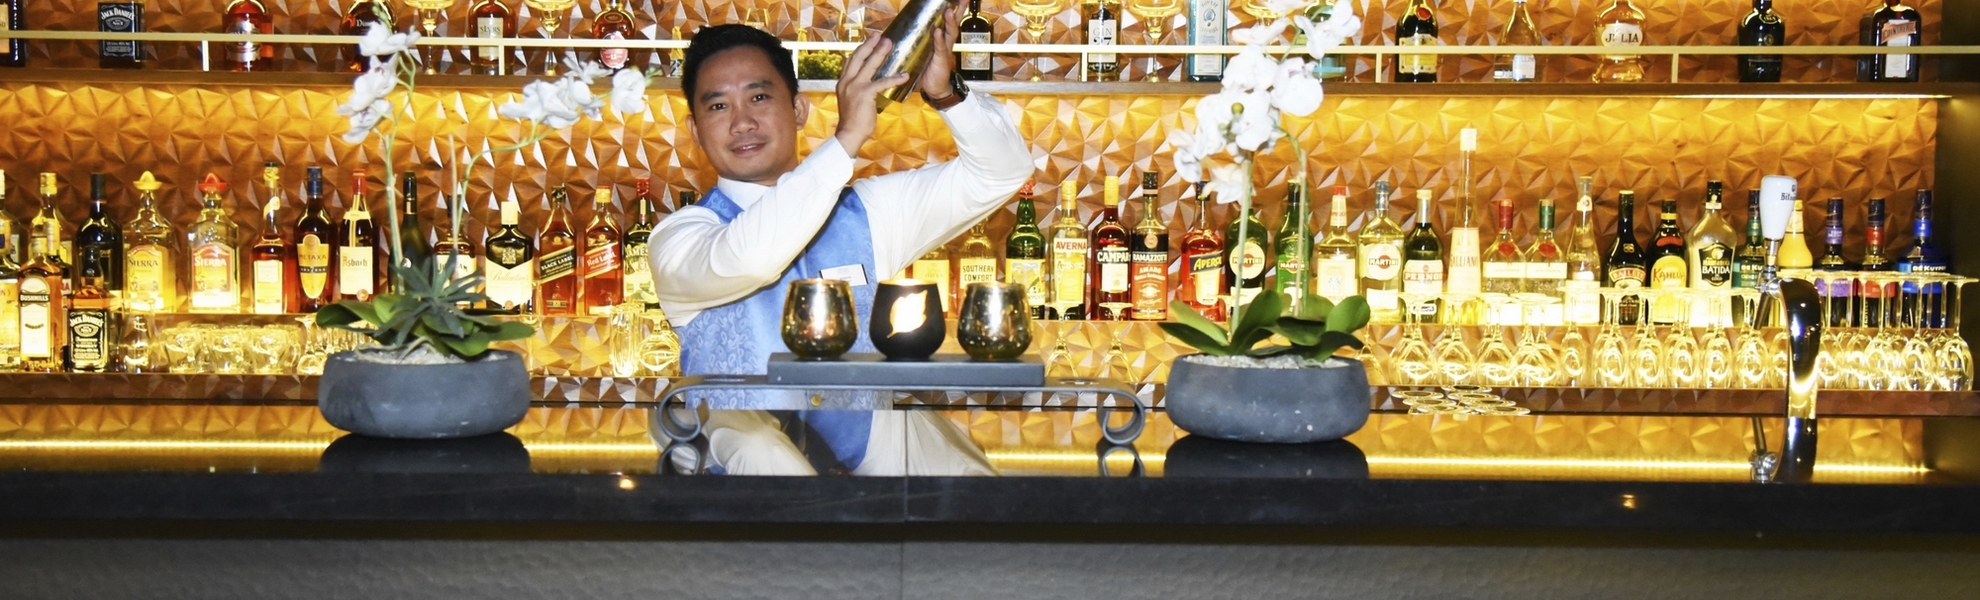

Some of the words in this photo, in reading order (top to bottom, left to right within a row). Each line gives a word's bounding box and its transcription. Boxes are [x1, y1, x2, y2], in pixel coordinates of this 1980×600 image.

[1093, 27, 1112, 36] GIN
[1056, 241, 1087, 250] AVERNA
[129, 259, 159, 267] SIERRA
[194, 255, 228, 267] SIERRA
[541, 260, 558, 271] BLACK
[558, 255, 574, 265] LABEL
[587, 257, 600, 267] Red
[1232, 256, 1263, 264] MRTINI
[962, 265, 995, 273] SOUTHERN
[1702, 265, 1731, 274] BATIDA
[964, 273, 993, 282] COMFORT
